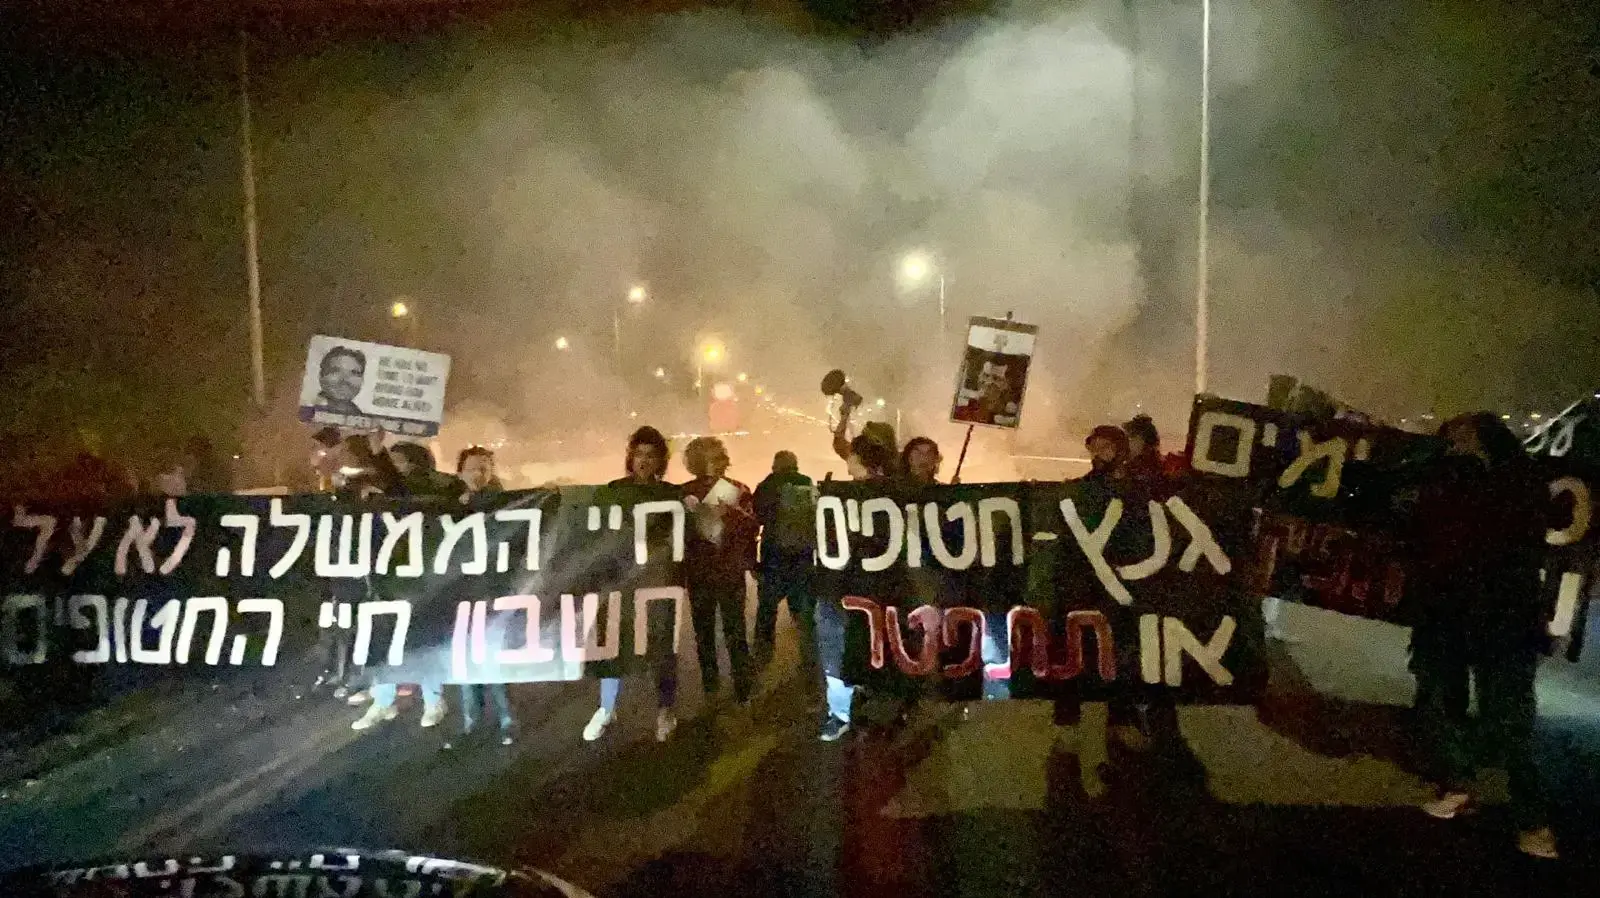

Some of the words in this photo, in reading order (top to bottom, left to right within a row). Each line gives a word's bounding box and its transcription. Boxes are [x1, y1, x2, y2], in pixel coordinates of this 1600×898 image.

[11, 503, 107, 577] על
[114, 498, 197, 577] לא
[215, 498, 542, 579] הממשלה
[588, 501, 686, 565] חיי
[2, 593, 285, 667] החטופים
[319, 600, 412, 667] חיי
[452, 586, 686, 681] חשבון
[842, 595, 1117, 681] תתפטר
[1140, 614, 1237, 687] או
